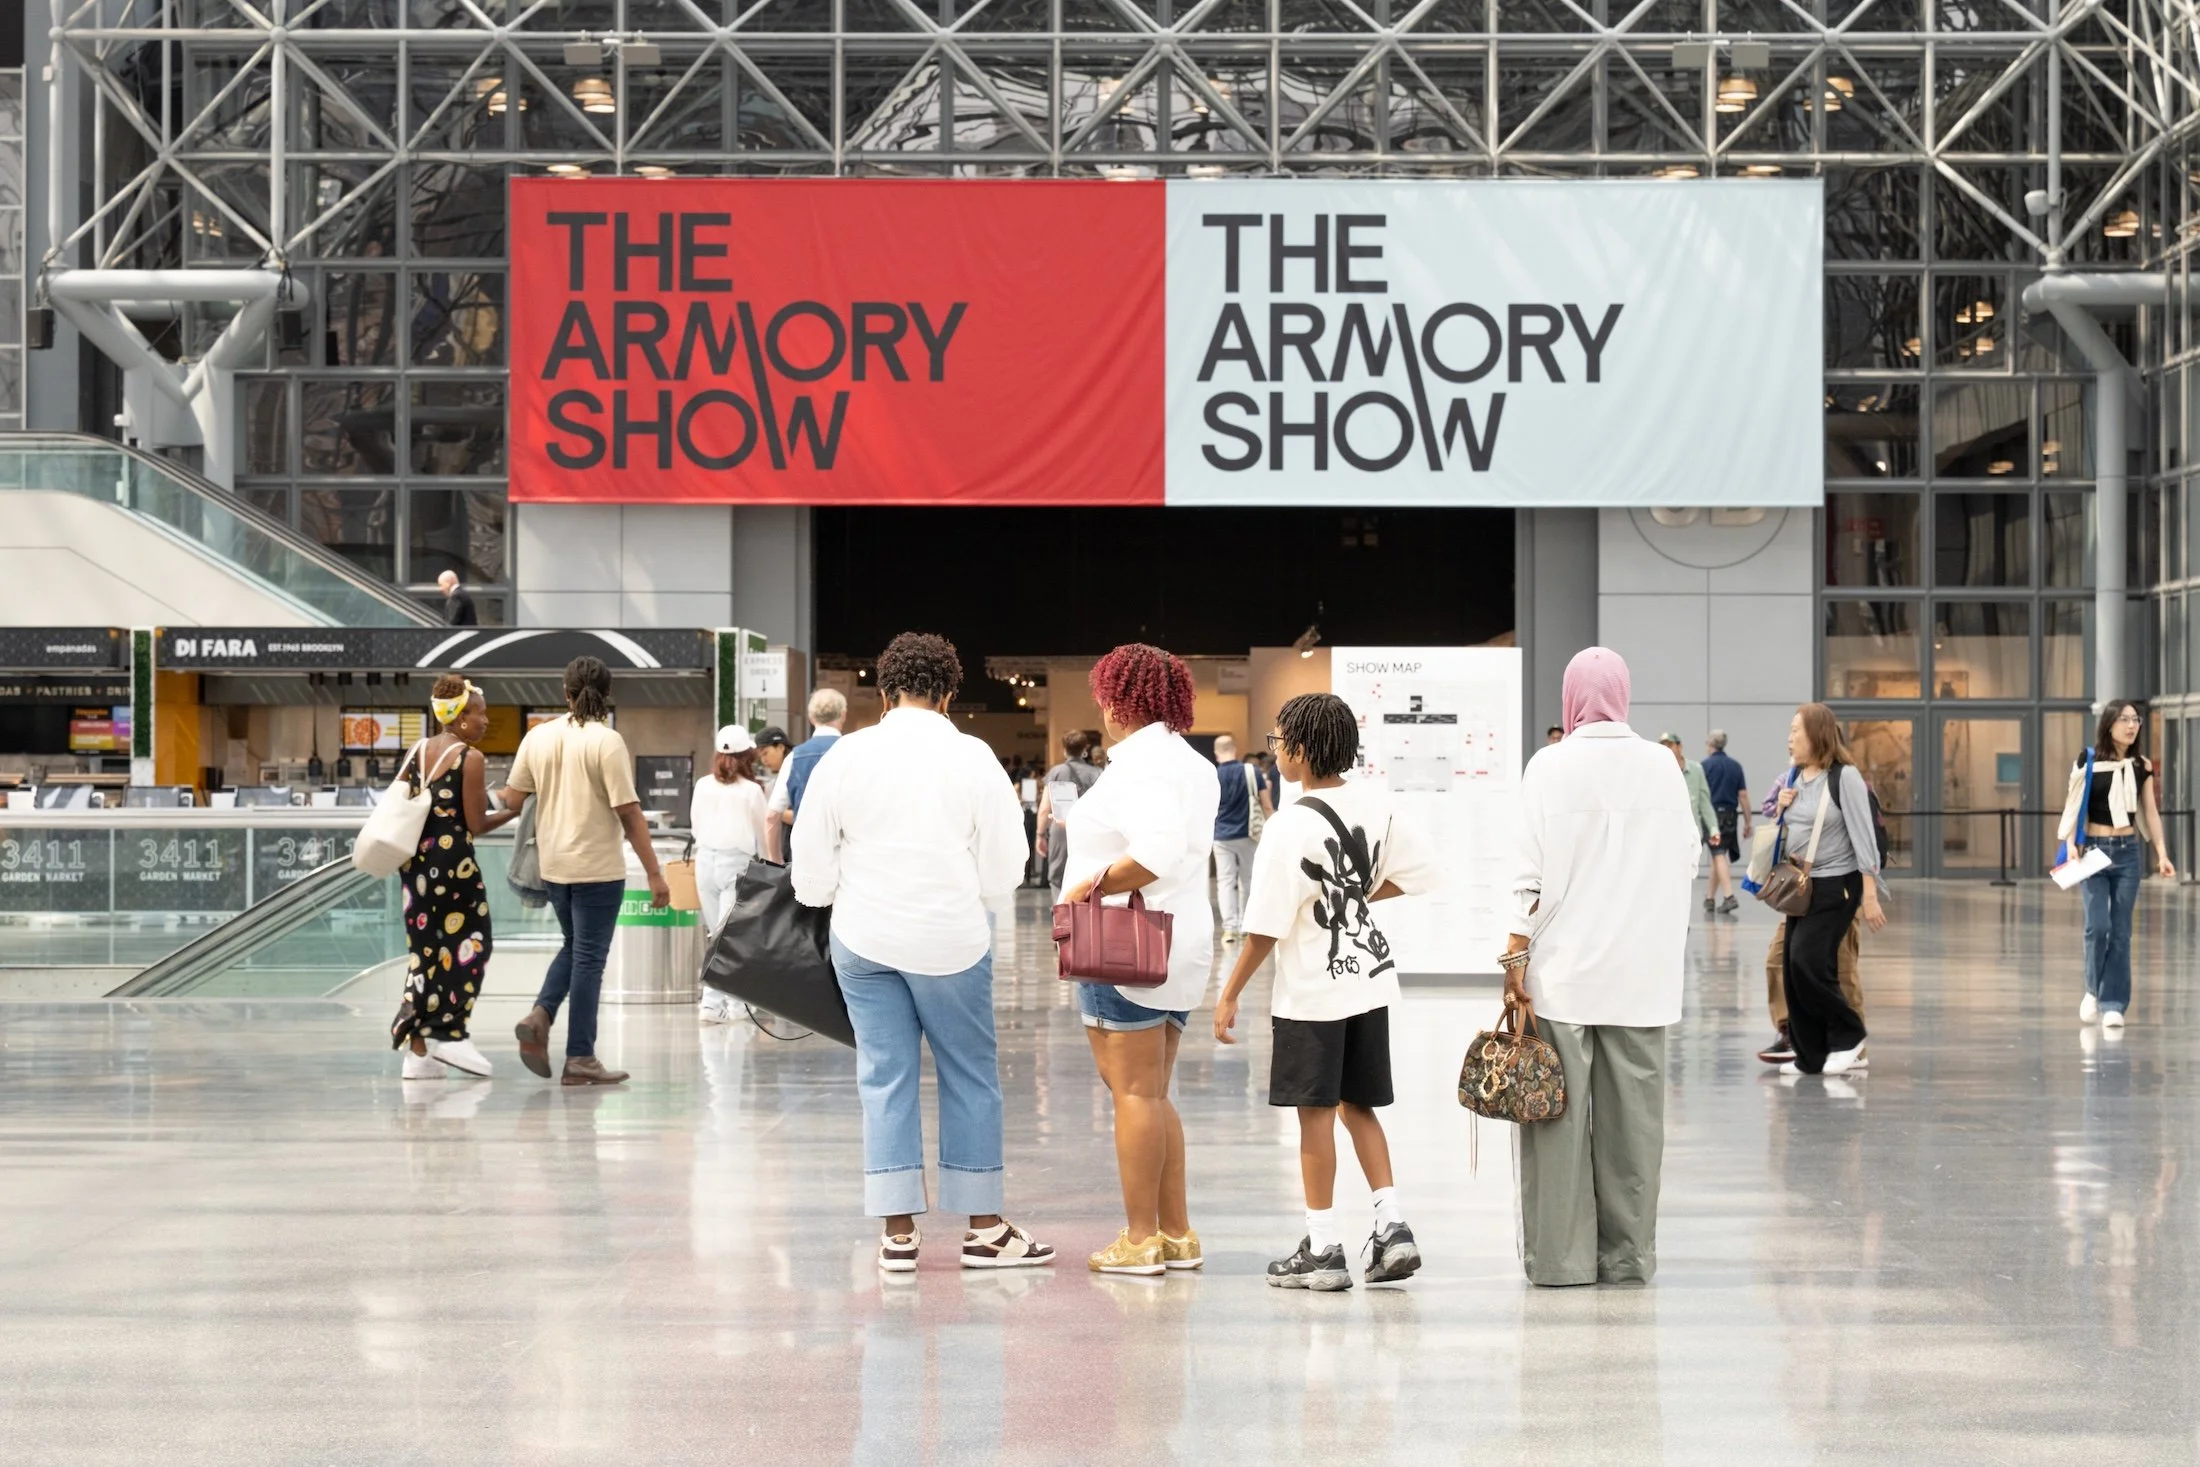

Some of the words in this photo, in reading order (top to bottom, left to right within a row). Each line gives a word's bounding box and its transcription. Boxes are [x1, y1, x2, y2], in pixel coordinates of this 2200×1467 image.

[547, 212, 733, 292] THE
[1202, 213, 1388, 293] THE
[541, 301, 968, 383] ARMORY
[1197, 302, 1624, 384] ARMORY
[545, 388, 850, 471] SHOW
[1201, 391, 1507, 473] SHOW
[46, 644, 97, 654] empanadas
[175, 639, 197, 657] DI
[202, 639, 257, 657] FARA
[301, 643, 344, 652] BROOKLYN
[1347, 662, 1389, 674] SHOW
[1392, 662, 1422, 673] MAP
[36, 686, 92, 697] PASTRIES
[1, 839, 86, 869] 3411
[138, 838, 222, 868] 3411
[1, 872, 40, 882] GARDEN
[45, 872, 84, 882] MARKET
[139, 871, 178, 881] GARDEN
[183, 871, 221, 881] MARKET
